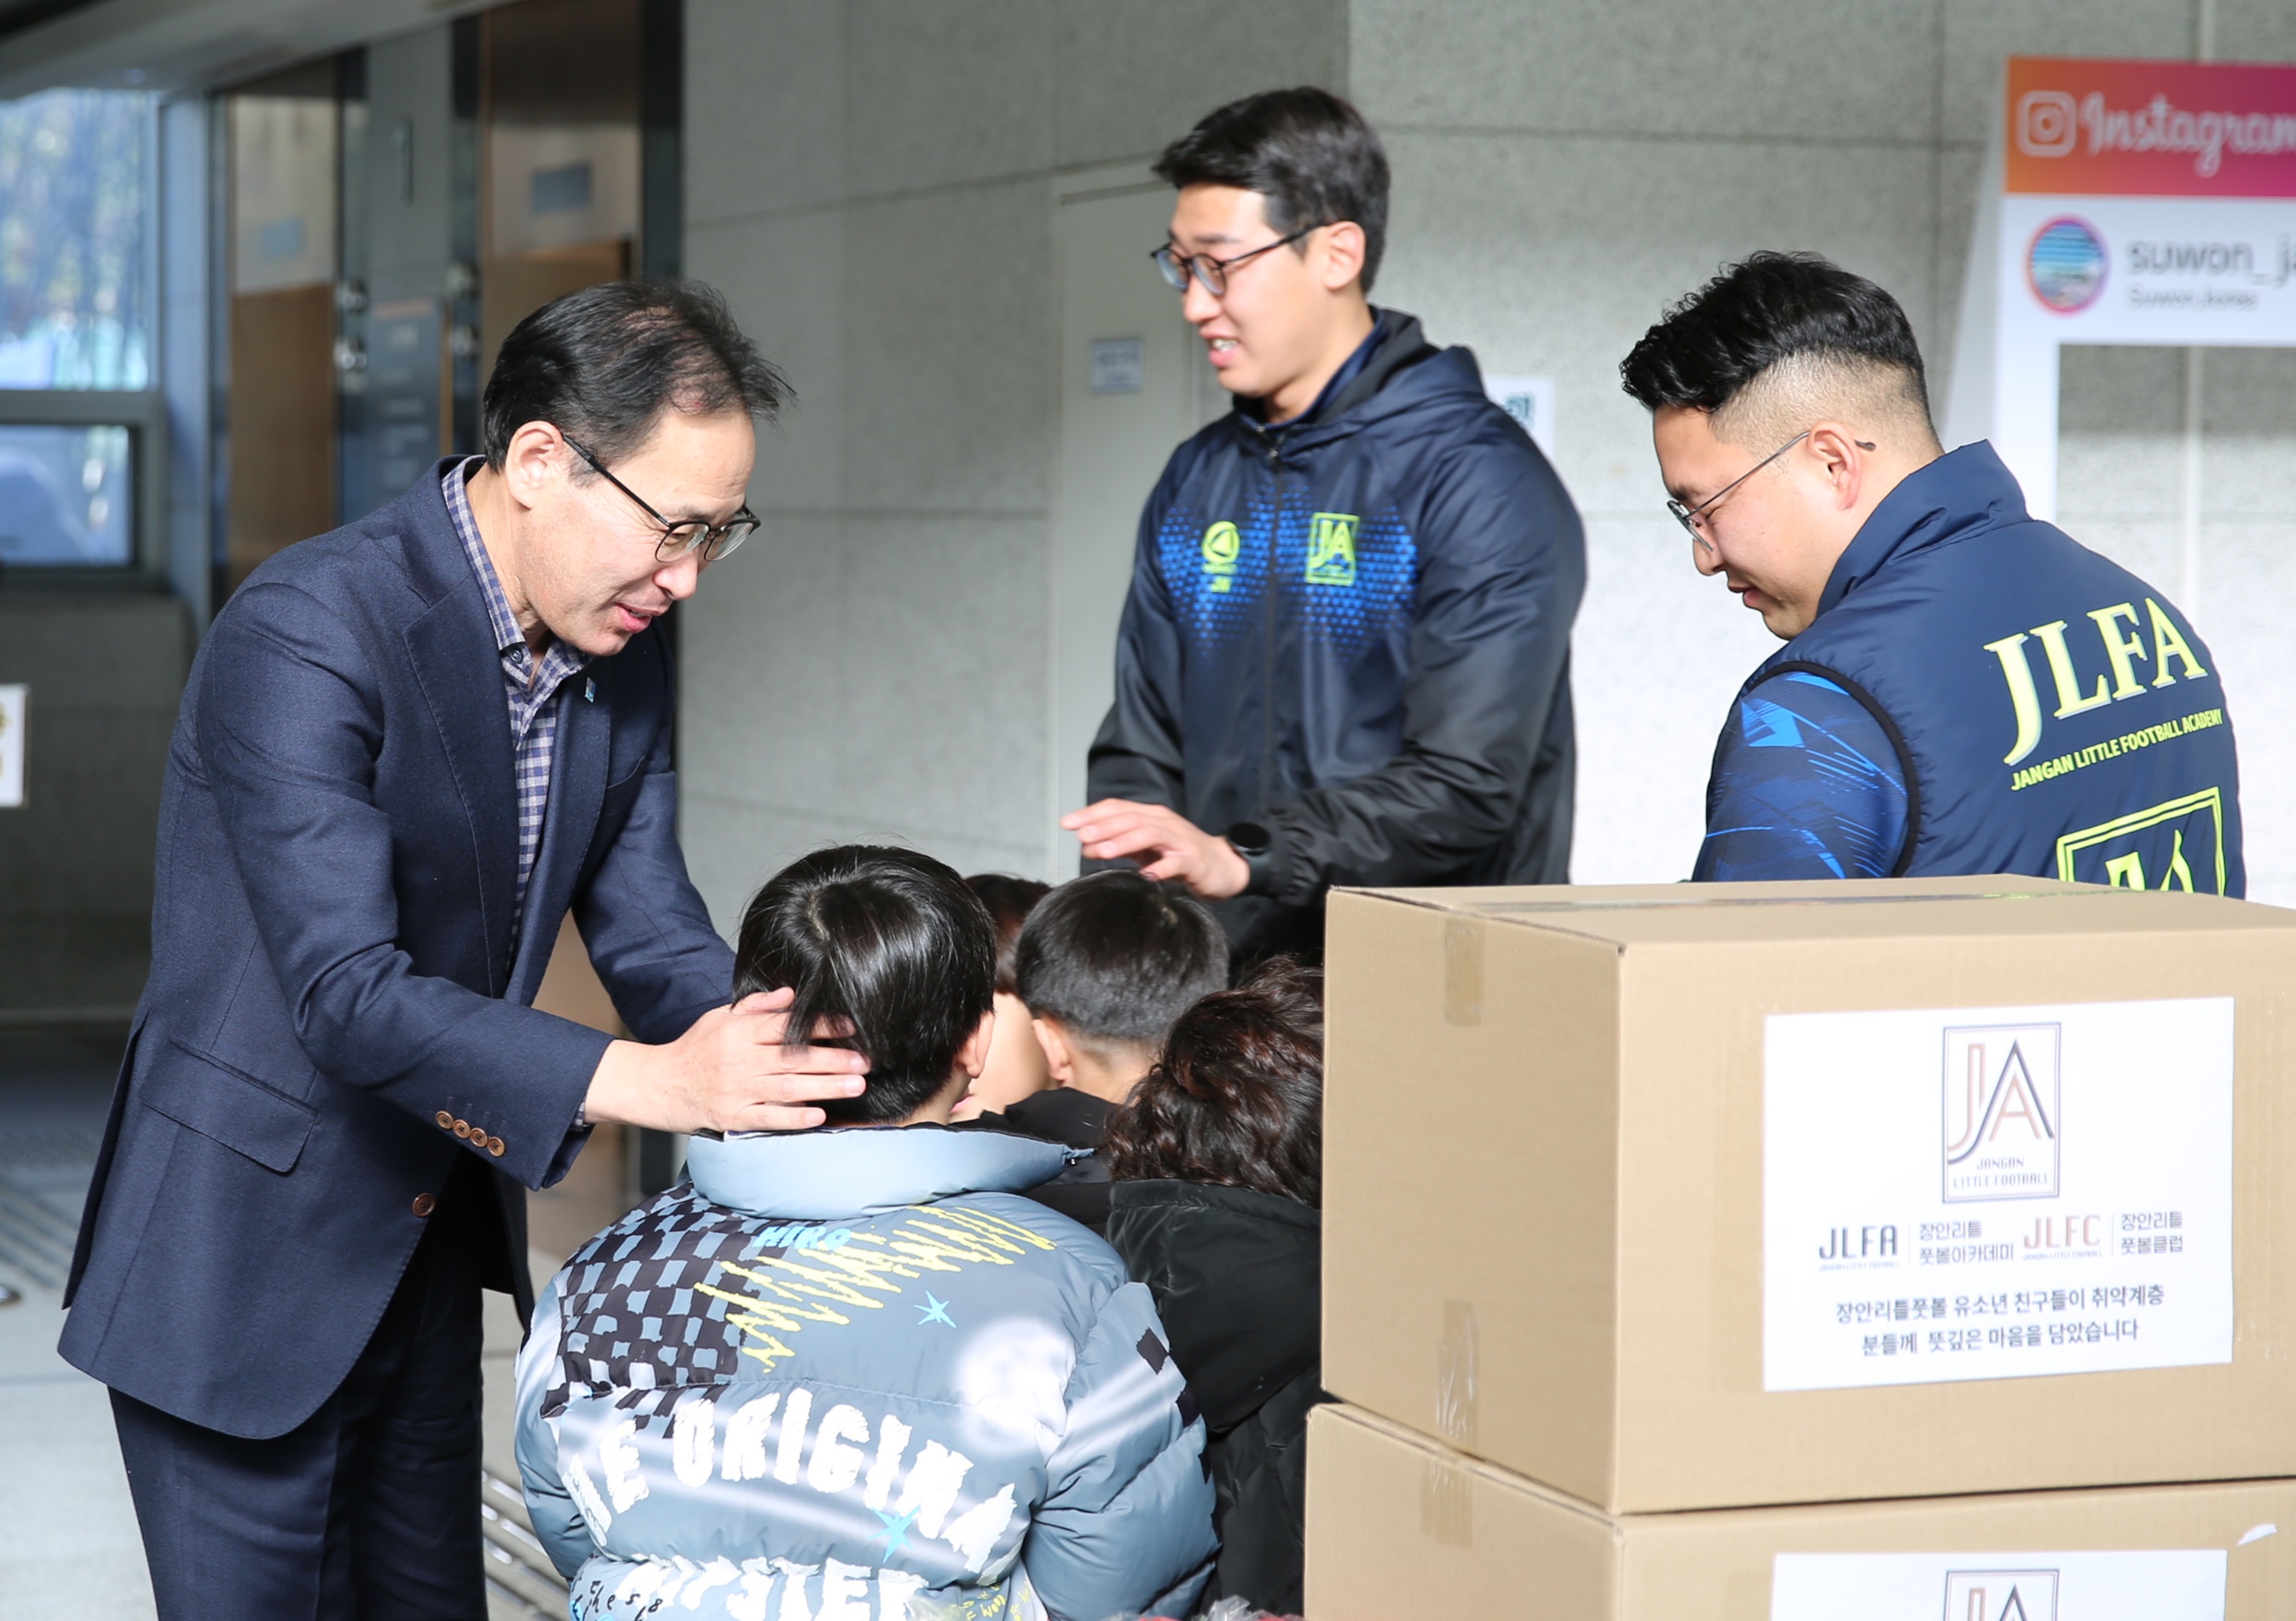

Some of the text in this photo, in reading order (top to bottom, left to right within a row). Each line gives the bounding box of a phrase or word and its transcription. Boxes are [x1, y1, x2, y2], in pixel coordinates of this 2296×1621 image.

[1309, 520, 1356, 569] JA
[1983, 597, 2208, 766] JLFA
[2010, 708, 2224, 791] JANGAN LITTLE FOOTBALL ACADEMY
[1947, 1037, 2056, 1166] JA
[1953, 1172, 2050, 1190] LITTLE FOOTBALL
[1976, 1157, 2025, 1171] JANGAN
[751, 1225, 852, 1251] HIRO
[1919, 1219, 1982, 1242] 장안리틀
[2023, 1214, 2102, 1250] JLFC
[2120, 1211, 2183, 1231] 장안리틀
[1819, 1224, 1899, 1260] JLFA
[1919, 1242, 2015, 1266] 풋볼아카데미
[2120, 1235, 2183, 1256] 풋볼클럽
[1836, 1283, 2165, 1324] 장안리틀풋볼 유소년 친구들이 취약계층
[1862, 1318, 2139, 1358] 분들께 뜻깊은 마음을 담았습니다
